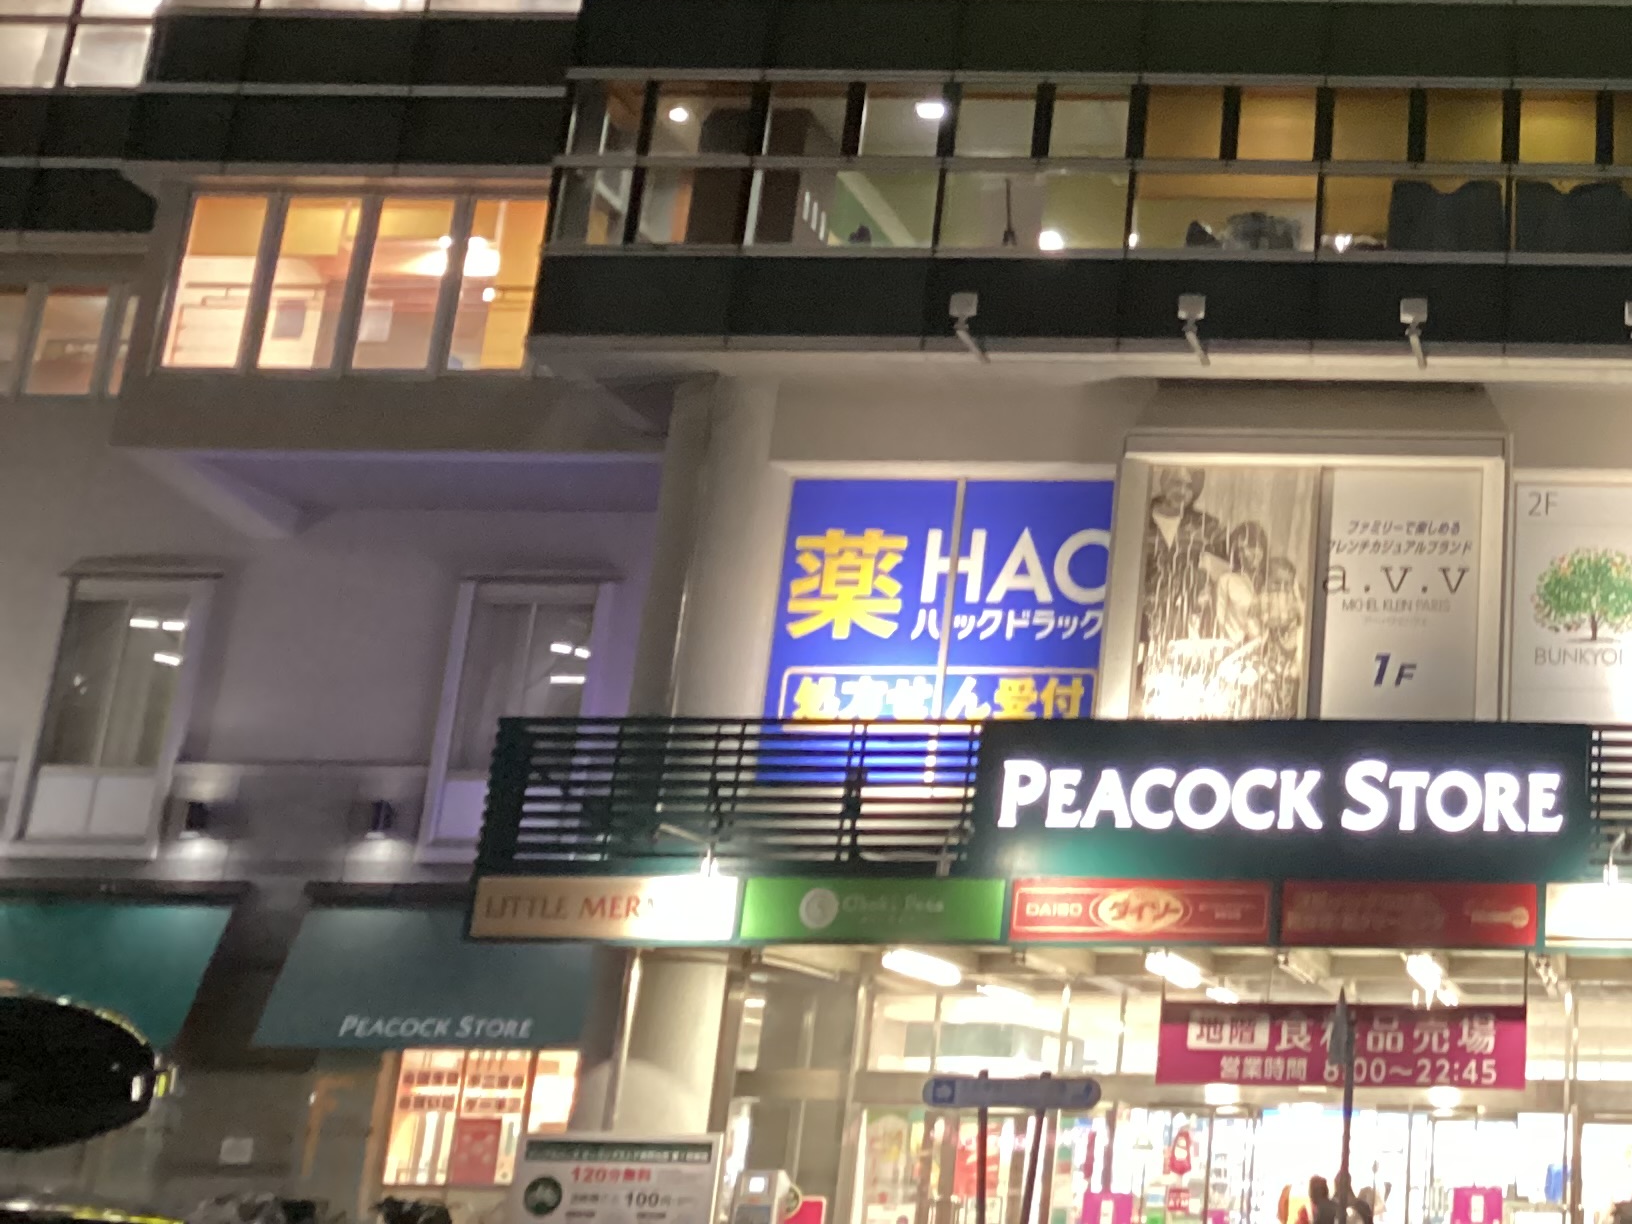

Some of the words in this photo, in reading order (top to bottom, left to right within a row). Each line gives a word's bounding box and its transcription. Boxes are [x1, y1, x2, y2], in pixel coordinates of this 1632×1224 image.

[1528, 492, 1557, 516] 2F
[1348, 520, 1461, 536] ファミリーで楽しめる
[787, 527, 908, 640] 薬
[1534, 647, 1623, 666] BUNKYO
[1373, 653, 1417, 687] 1F
[793, 676, 1084, 719] 処方せん受付
[998, 759, 1323, 831] PEACOCK
[1340, 760, 1563, 833] STORE
[485, 890, 568, 914] LITTLE
[1026, 902, 1082, 917] DAISO
[338, 1015, 451, 1038] PEACOCK
[455, 1015, 533, 1039] STORE
[1275, 1010, 1496, 1054] 食品売場
[1220, 1056, 1308, 1082] 営業時間
